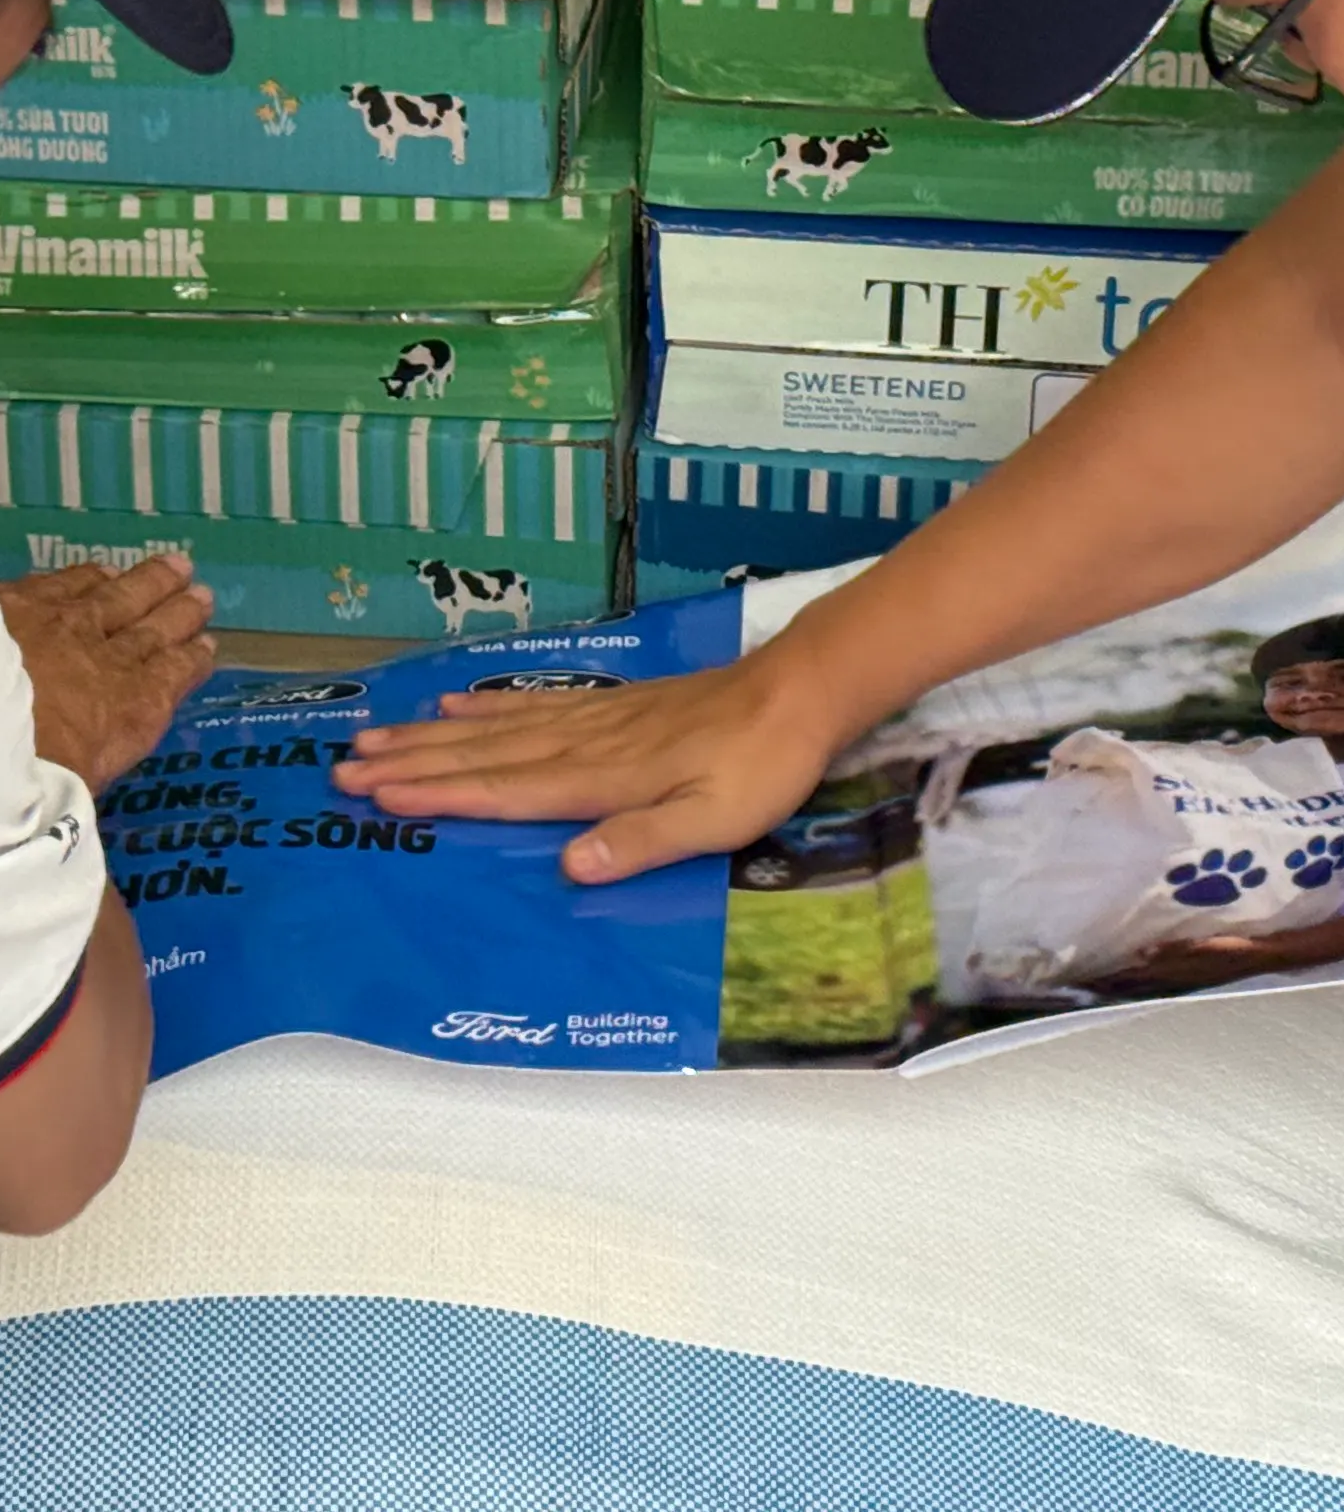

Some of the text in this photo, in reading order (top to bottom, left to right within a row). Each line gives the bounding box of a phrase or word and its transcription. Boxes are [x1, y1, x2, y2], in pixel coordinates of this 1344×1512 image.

[1093, 166, 1149, 191] 100%
[863, 278, 1011, 354] TH
[783, 370, 966, 402] SWEETENED
[577, 635, 642, 649] FORD
[136, 751, 203, 778] RD
[125, 812, 274, 859] CUỘC
[430, 1010, 559, 1046] Ford
[566, 1012, 669, 1030] Building
[566, 1028, 679, 1048] Together
